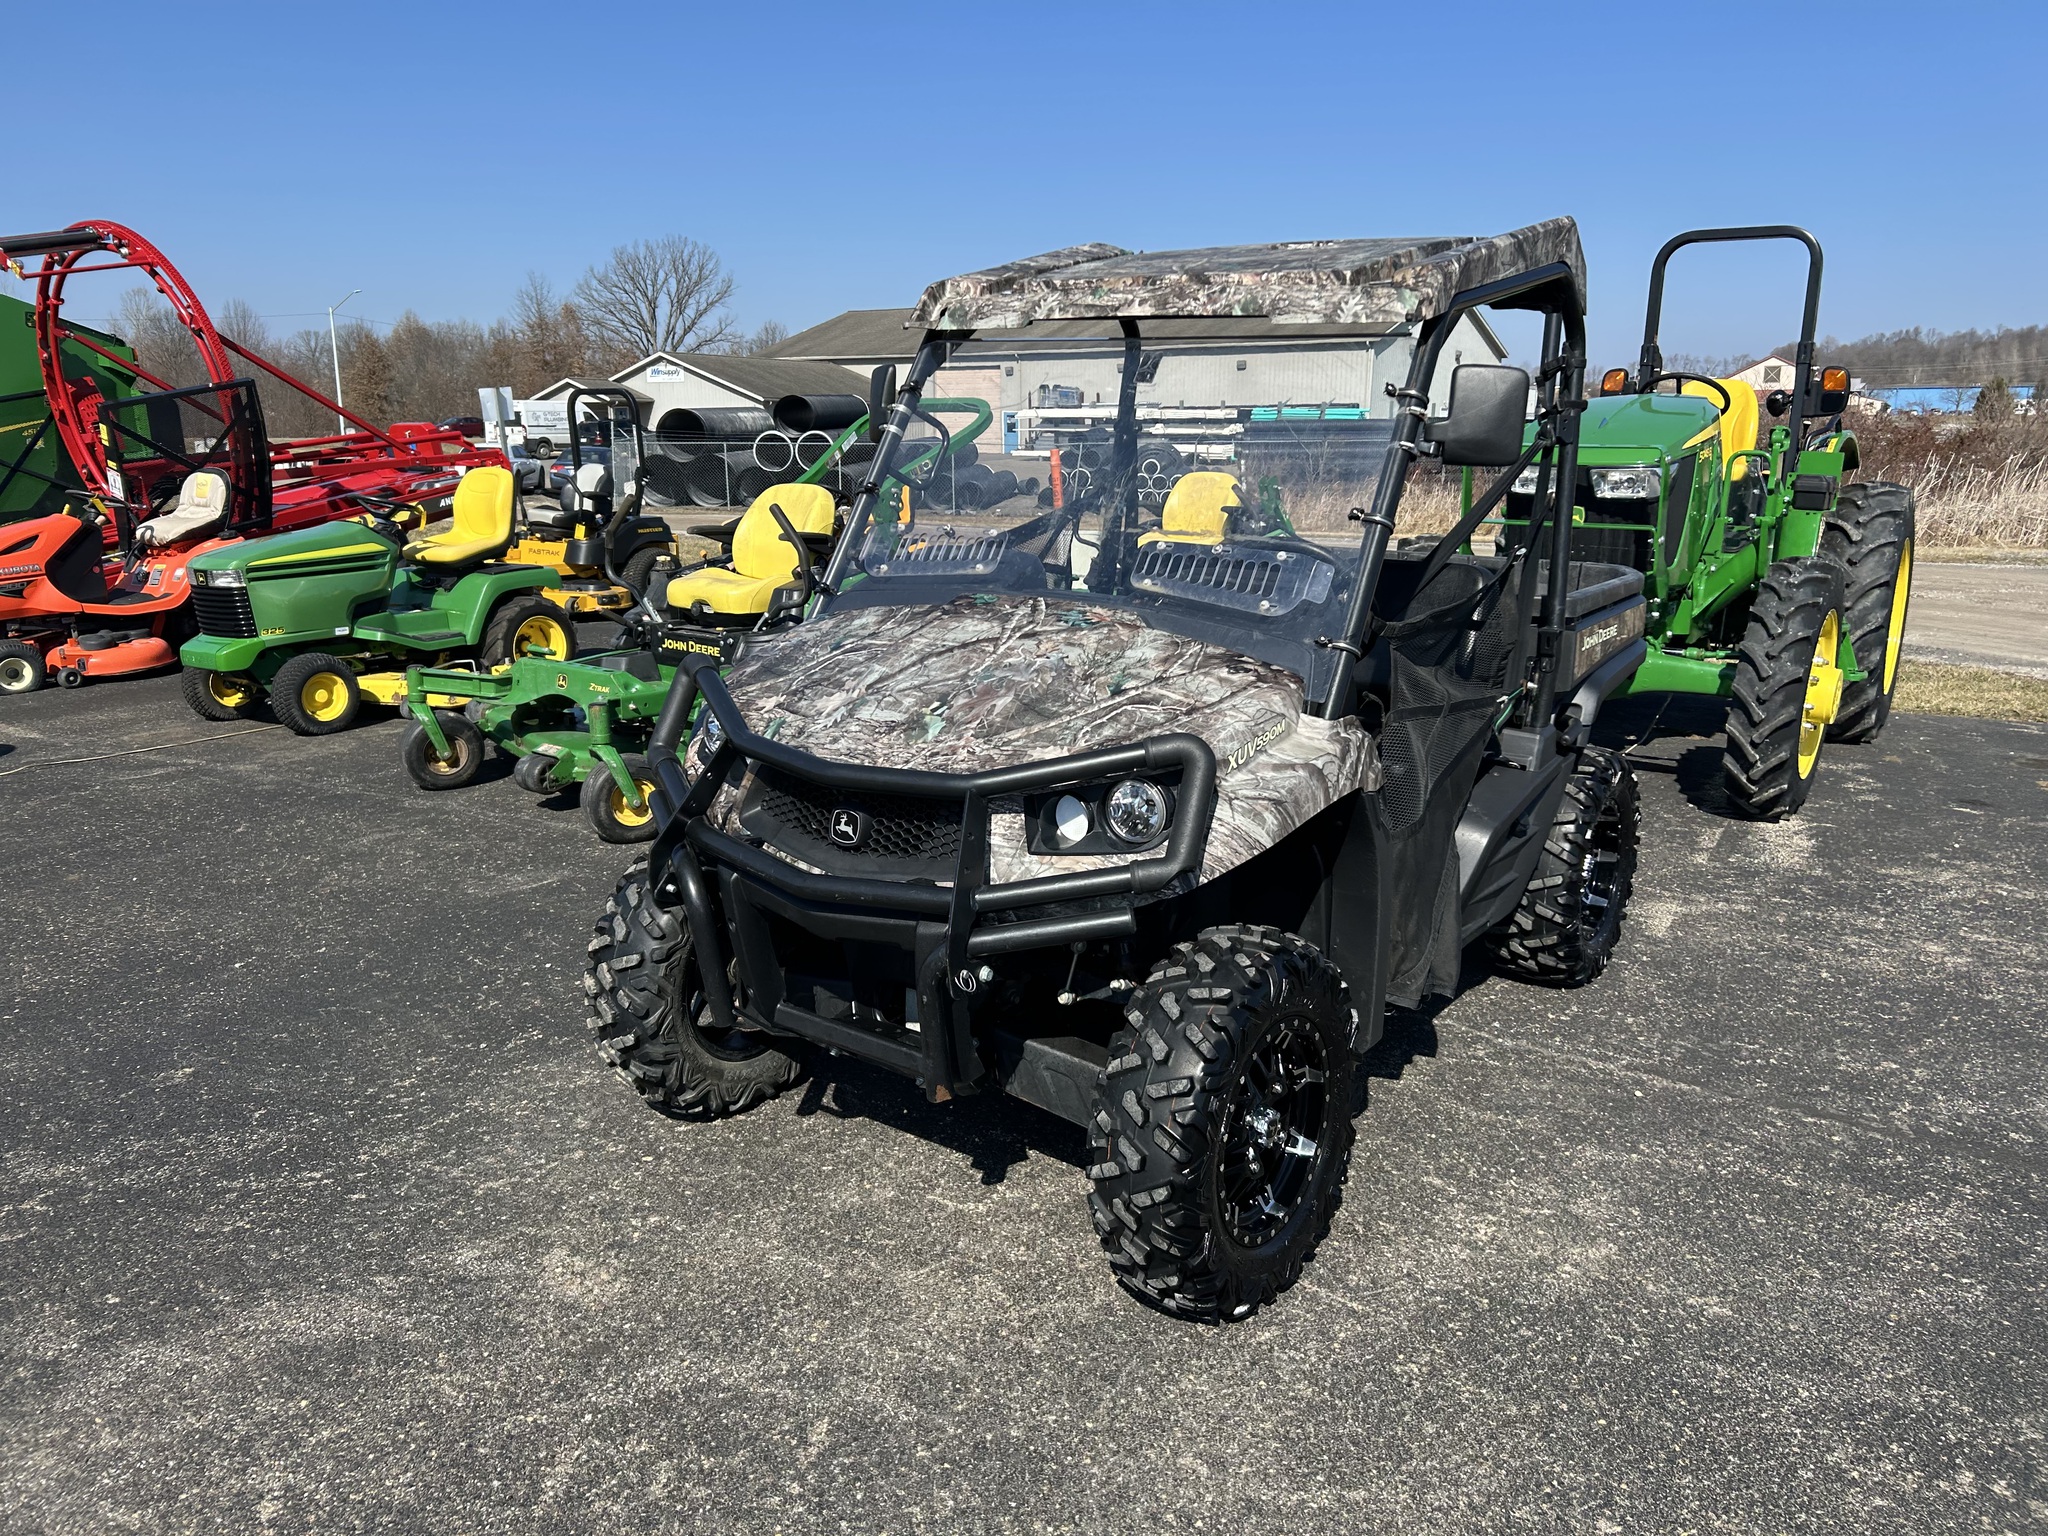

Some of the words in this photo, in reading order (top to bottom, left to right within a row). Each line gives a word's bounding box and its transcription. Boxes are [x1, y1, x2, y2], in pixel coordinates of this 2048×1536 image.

[651, 368, 680, 377] Winsupply
[528, 547, 560, 557] FASTRAK
[261, 626, 286, 637] 325
[1581, 630, 1599, 651] JOHN
[1598, 624, 1618, 643] DEERE
[662, 638, 687, 652] JOHN
[688, 641, 721, 657] DEERE
[589, 682, 610, 694] ZTRAK
[1226, 717, 1286, 775] XUV590M
